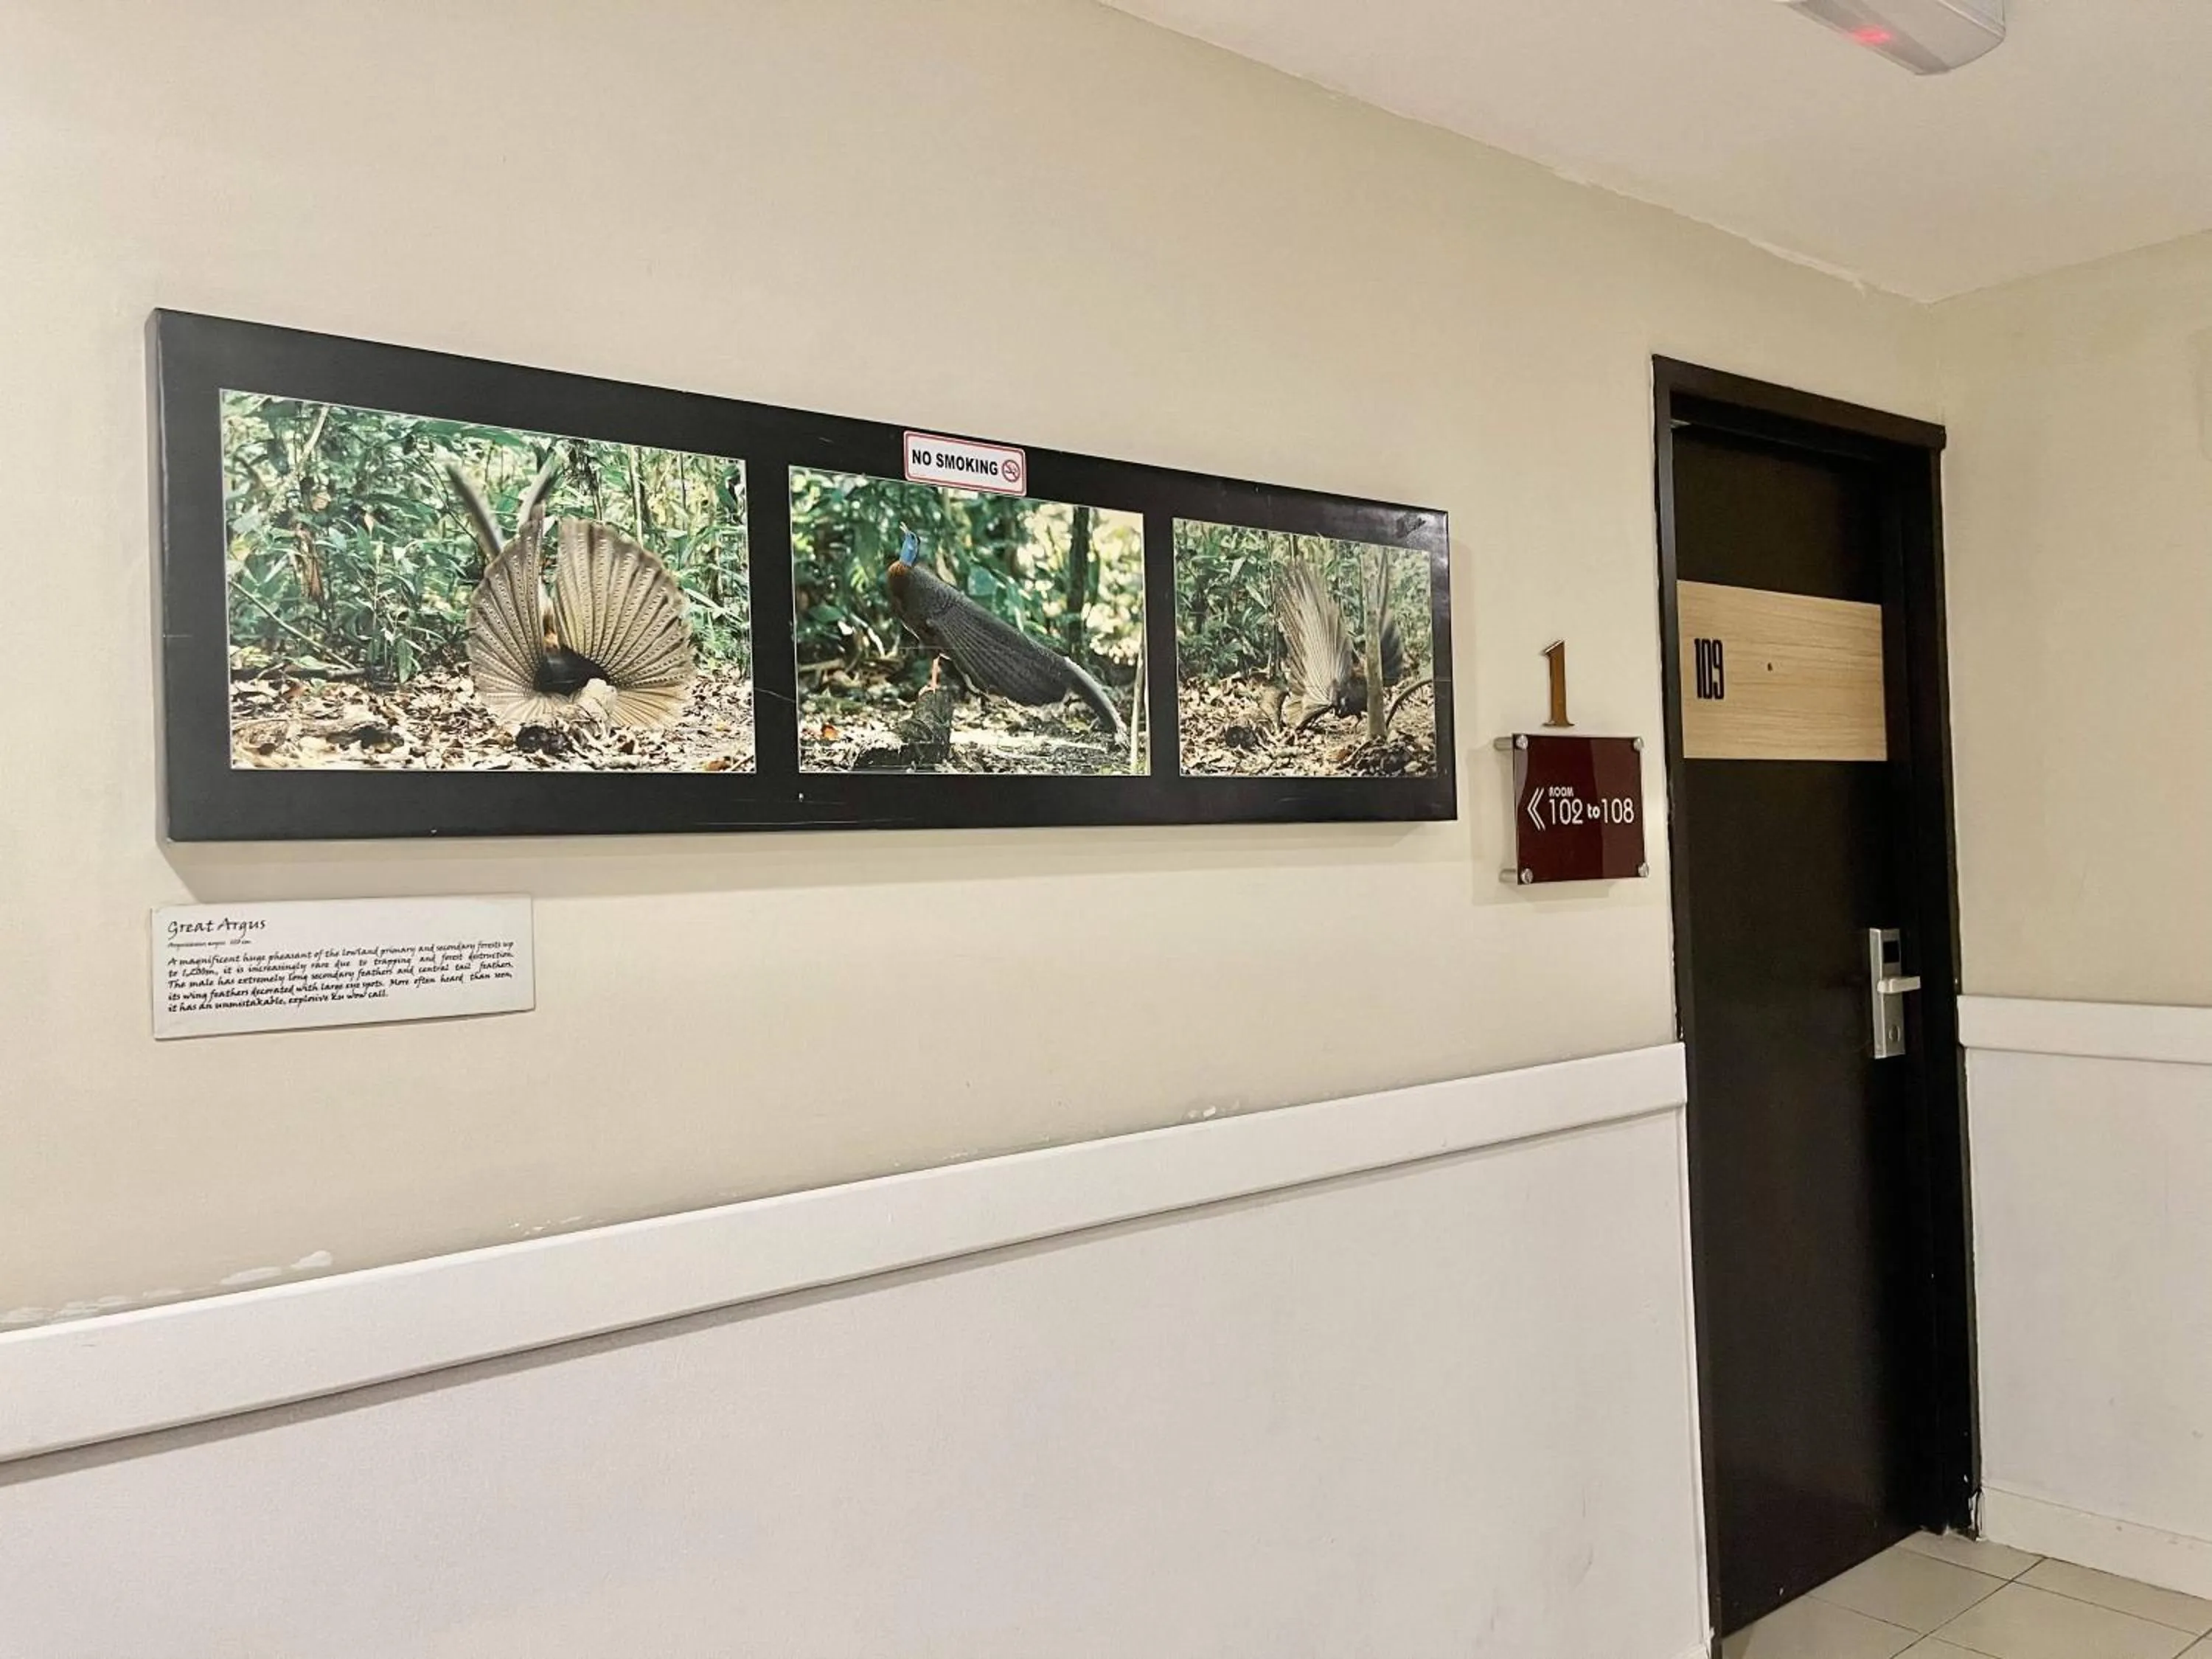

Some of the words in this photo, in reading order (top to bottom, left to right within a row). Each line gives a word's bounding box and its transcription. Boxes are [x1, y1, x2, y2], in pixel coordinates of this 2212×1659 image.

[912, 449, 931, 466] NO
[936, 453, 998, 476] SMOKING
[1694, 638, 1725, 700] 109
[1542, 639, 1575, 727] 1
[1549, 786, 1574, 797] ROOM
[1549, 799, 1584, 825] 102
[1587, 802, 1600, 819] to
[1601, 798, 1635, 824] 108
[167, 921, 214, 940] Great
[217, 918, 266, 938] Argus
[169, 970, 177, 978] to
[248, 961, 307, 975] increasingly
[335, 959, 350, 970] due
[374, 958, 411, 970] trapping
[420, 953, 435, 964] and
[440, 952, 462, 966] forest
[179, 955, 240, 968] magnificent
[243, 953, 266, 966] huge
[267, 951, 312, 966] pheasant
[314, 949, 324, 961] of
[325, 948, 340, 958] the
[380, 947, 415, 958] primary
[418, 944, 434, 952] and
[436, 942, 476, 954] secondary
[476, 941, 501, 953] forests
[503, 942, 514, 950] up
[168, 978, 186, 988] The
[189, 978, 214, 987] male
[218, 975, 235, 985] has
[238, 974, 285, 987] extremely
[288, 973, 307, 985] long
[311, 970, 355, 981] secondary
[356, 967, 392, 981] feathers
[397, 965, 414, 976] and
[418, 964, 449, 973] central
[456, 962, 471, 971] tail
[183, 992, 207, 1003] wing
[209, 988, 248, 1004] feathers
[251, 984, 294, 997] decorated
[296, 982, 318, 992] with
[321, 983, 344, 993] large
[389, 978, 409, 987] More
[414, 975, 436, 989] often
[440, 973, 463, 984] heard
[470, 972, 490, 981] than
[168, 1004, 177, 1012] it
[179, 1002, 198, 1012] has
[288, 995, 329, 1008] explosive
